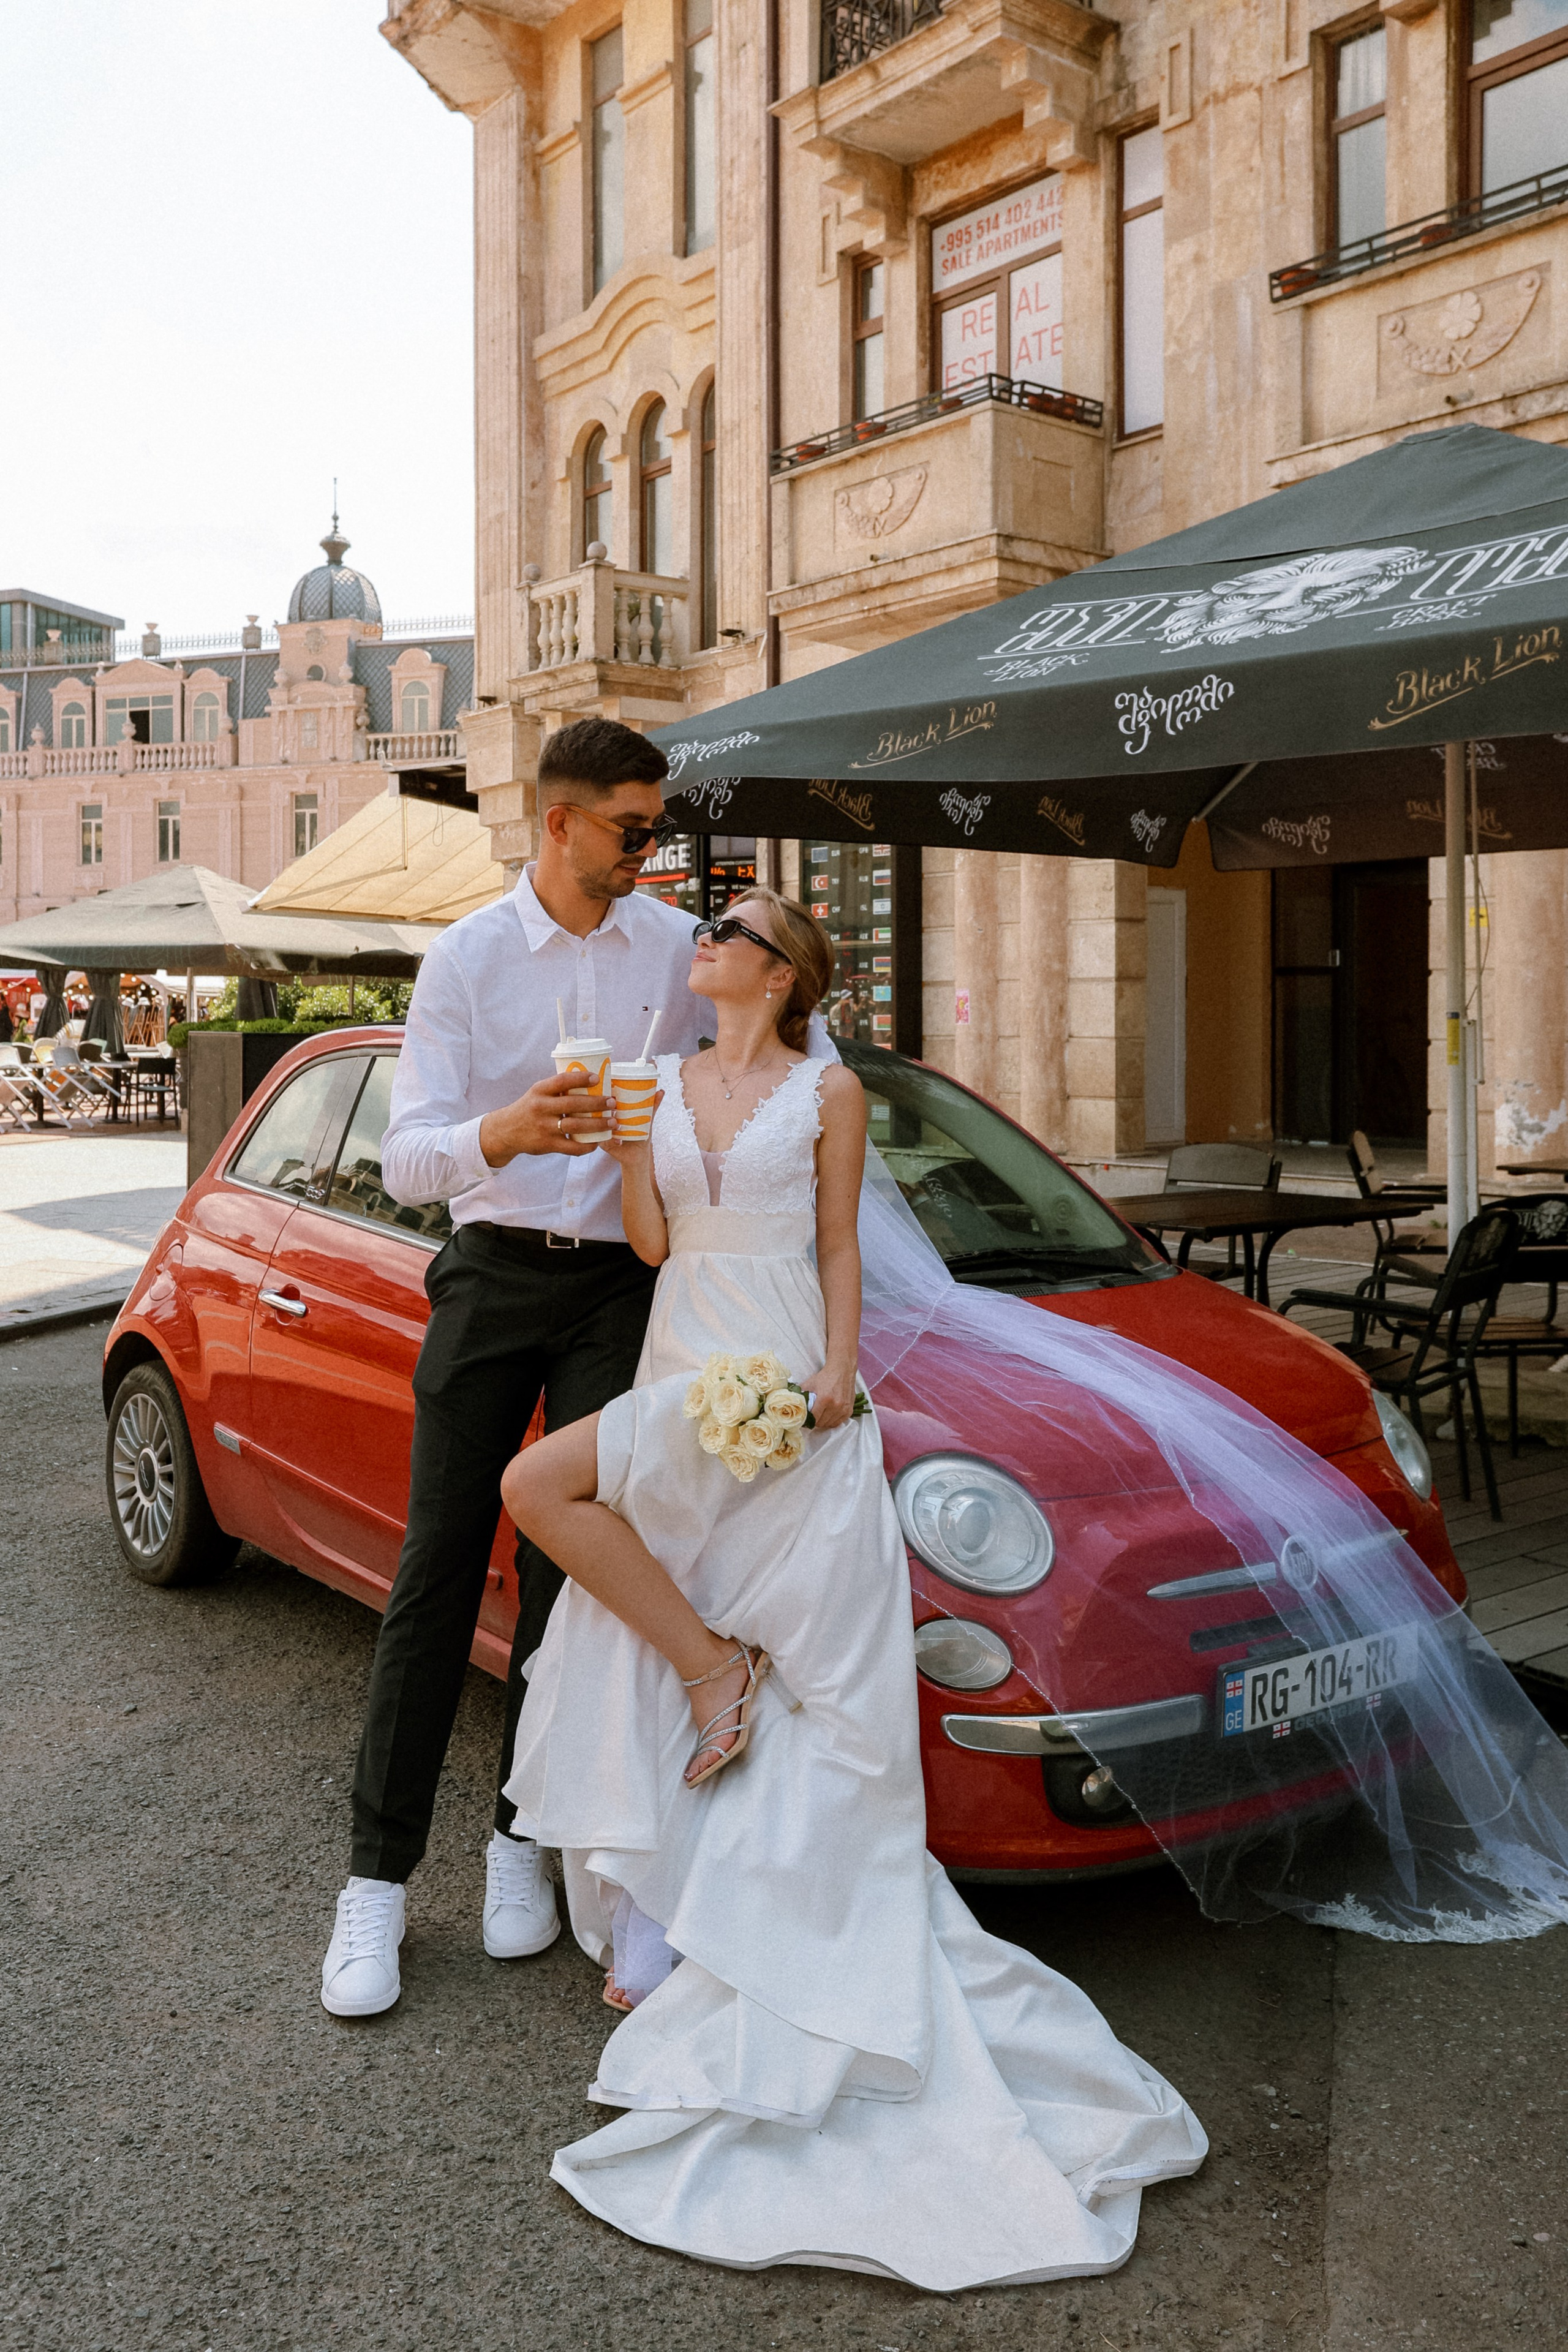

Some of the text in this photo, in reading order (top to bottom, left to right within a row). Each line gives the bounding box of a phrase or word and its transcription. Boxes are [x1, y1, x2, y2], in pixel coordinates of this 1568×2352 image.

[940, 187, 1063, 252] +995 514 402 442
[941, 250, 972, 276] SALE
[962, 282, 1050, 342] RE AL
[1392, 593, 1498, 620] CRAFT
[983, 652, 1090, 675] BLACK
[991, 666, 1057, 682] LION
[1385, 626, 1562, 714] Black Lion
[866, 701, 998, 761] Black Lion
[306, 1185, 325, 1200] 500
[1250, 1635, 1398, 1725] RG-104-RR
[1226, 1709, 1243, 1731] GE
